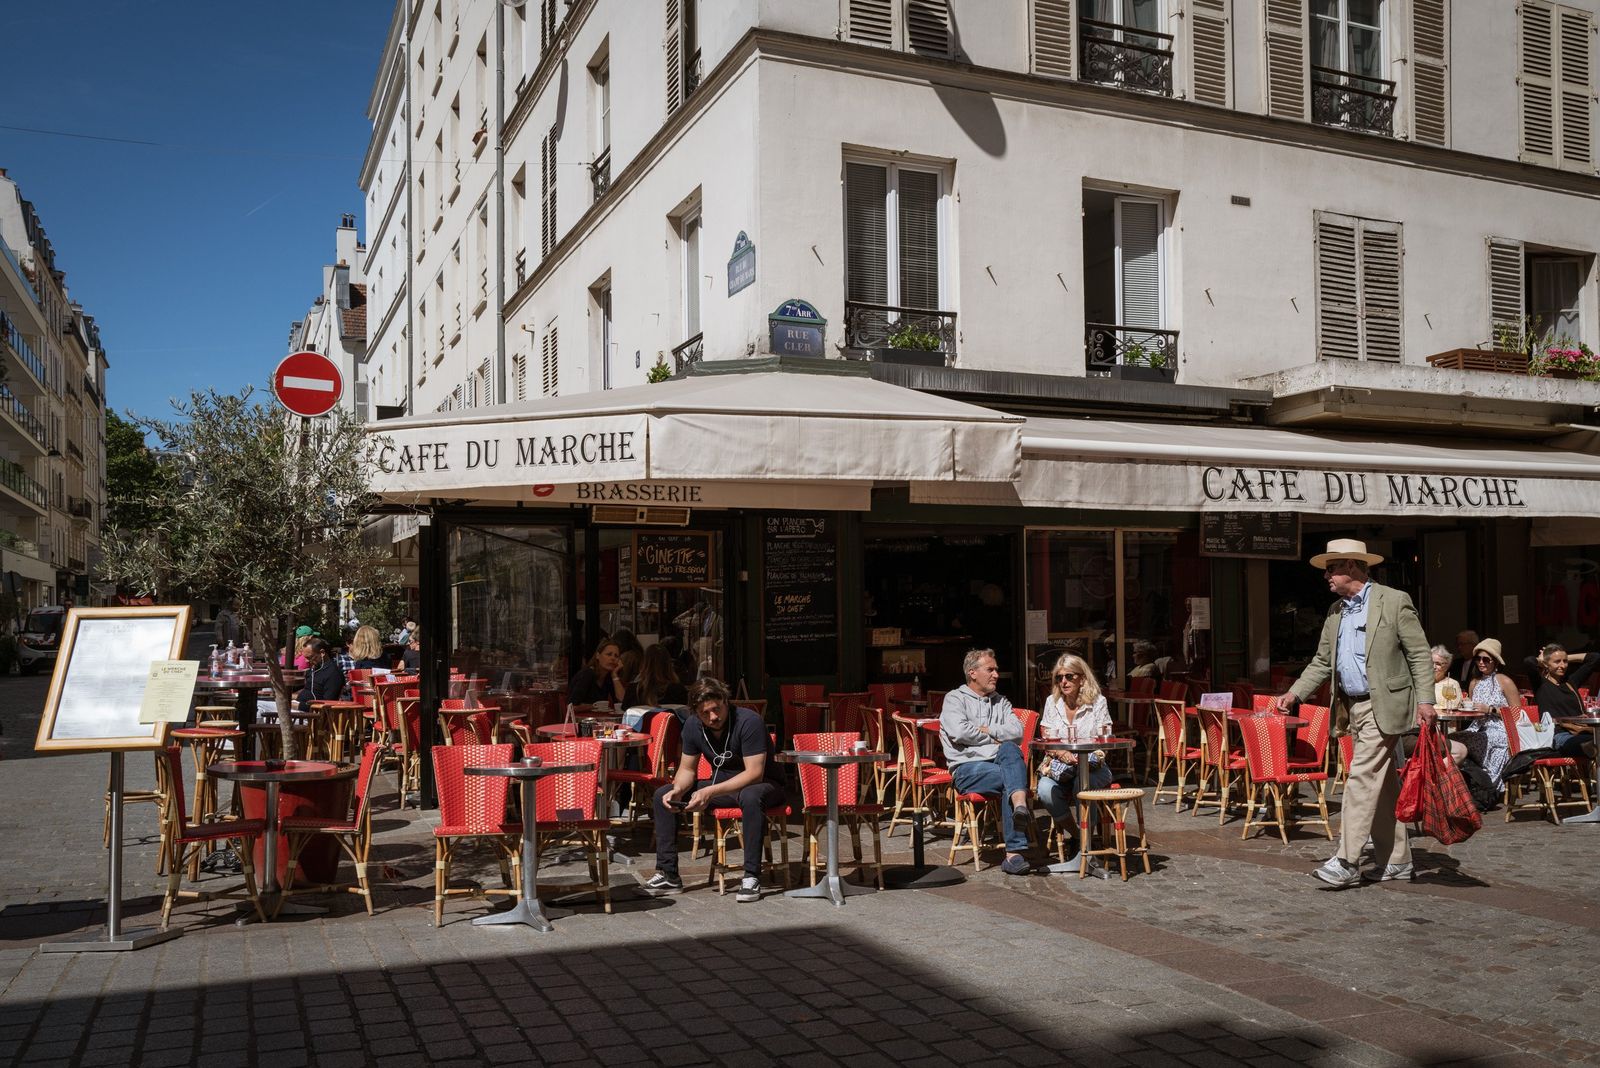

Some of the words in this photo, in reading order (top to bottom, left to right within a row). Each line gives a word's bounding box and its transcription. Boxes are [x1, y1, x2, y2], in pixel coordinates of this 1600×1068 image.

[787, 329, 809, 340] RUE
[784, 341, 811, 352] CLER
[379, 442, 450, 474] CAFE
[466, 439, 500, 469] DU
[516, 431, 636, 467] MARCHE
[577, 482, 704, 503] BRASSERIE
[1202, 466, 1306, 503] CAFE
[1324, 472, 1368, 505] DU
[1386, 475, 1528, 510] MARCHE
